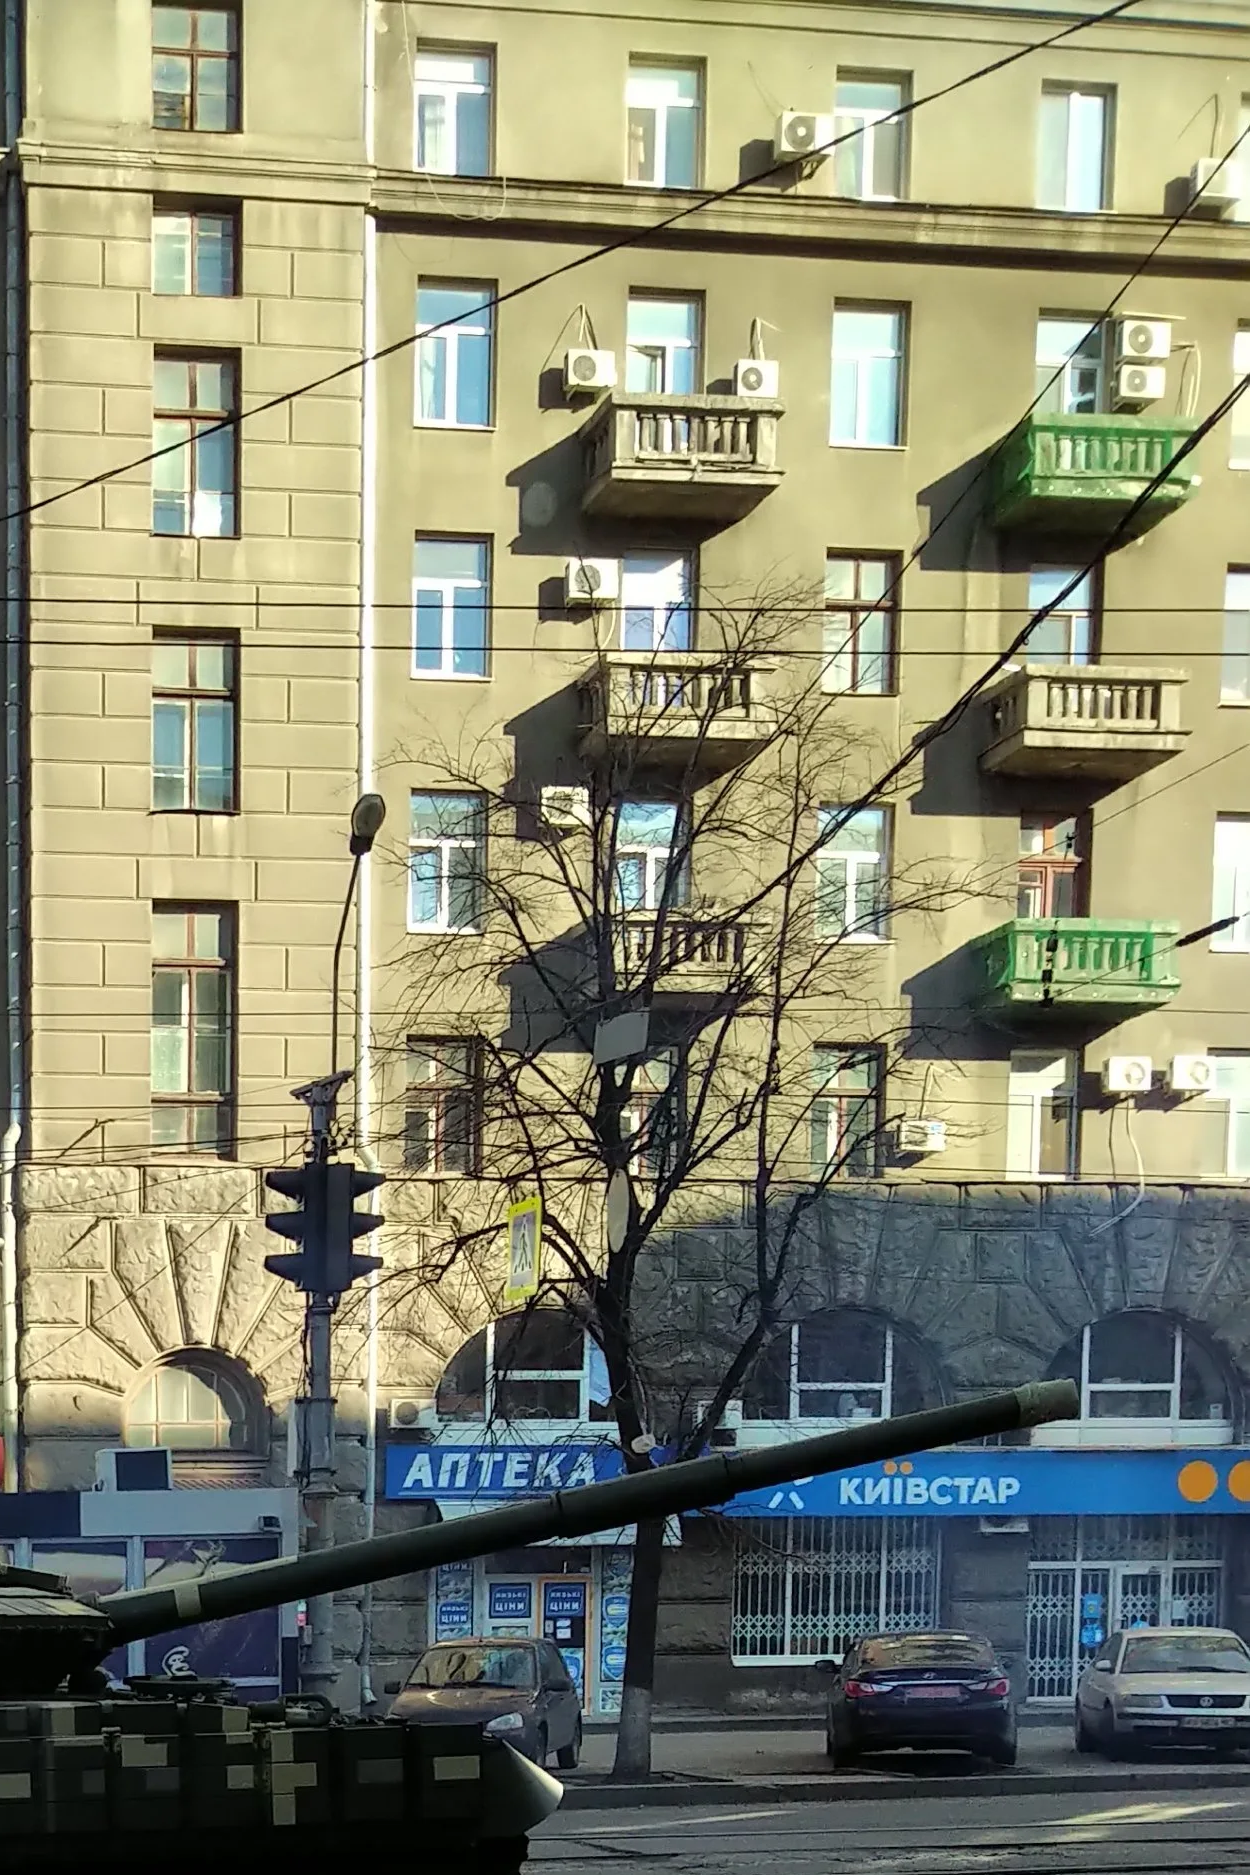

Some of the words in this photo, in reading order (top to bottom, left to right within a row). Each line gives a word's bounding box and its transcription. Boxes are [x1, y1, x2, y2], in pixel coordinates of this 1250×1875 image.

[402, 1453, 596, 1489] АПТЕКА
[839, 1460, 1020, 1505] КИЇВСТАР
[495, 1602, 525, 1612] ЦІНИ
[550, 1601, 579, 1612] ЦІНИ
